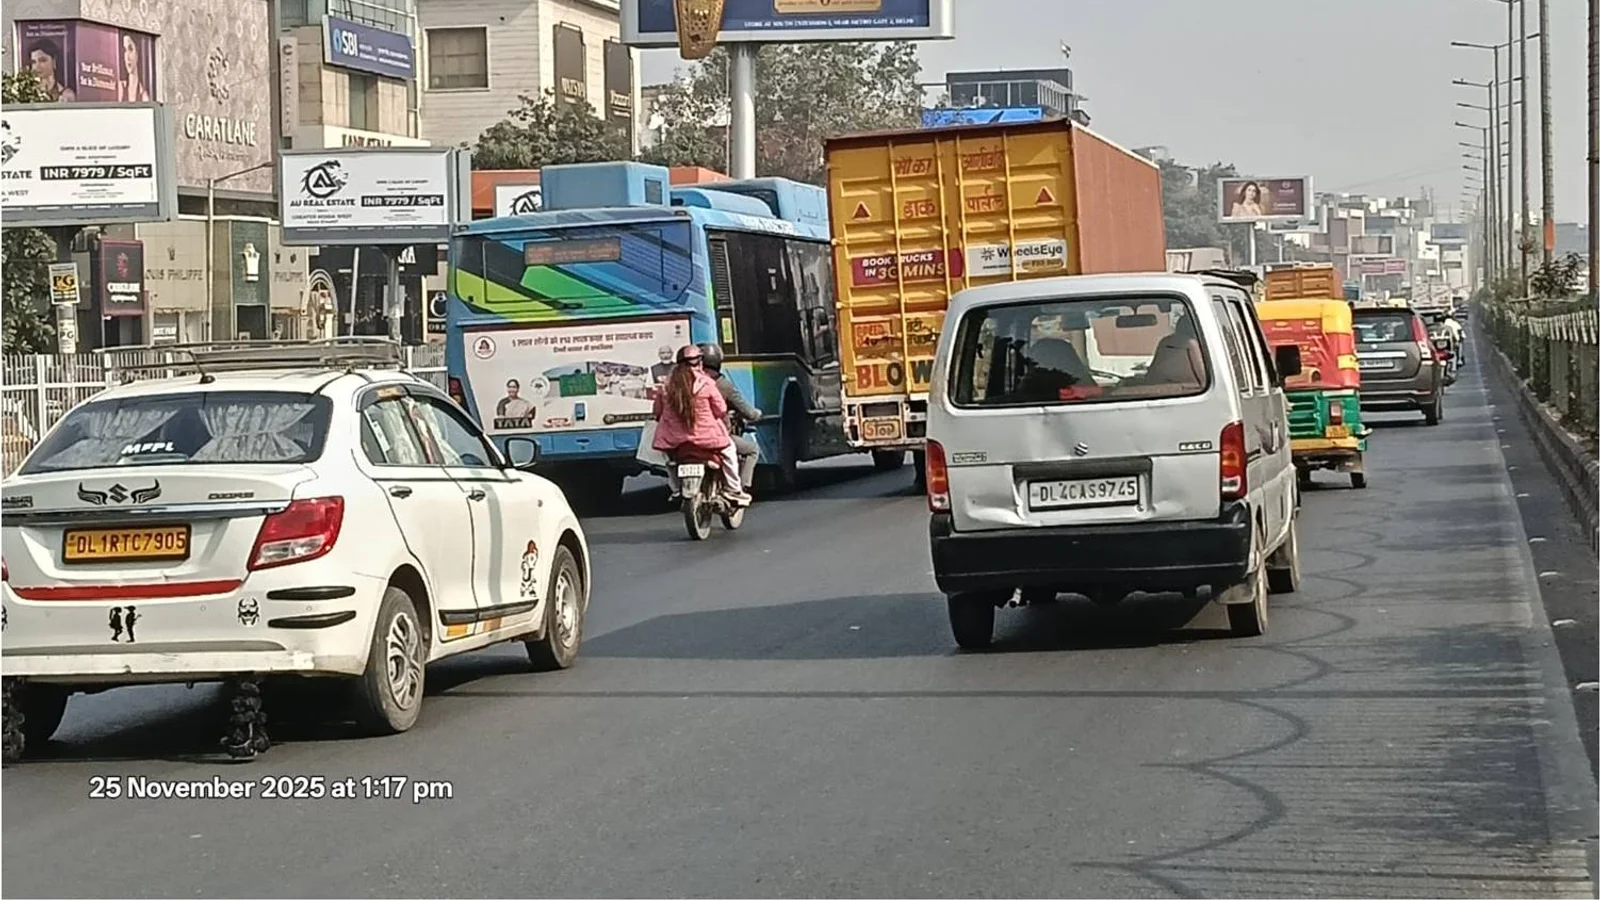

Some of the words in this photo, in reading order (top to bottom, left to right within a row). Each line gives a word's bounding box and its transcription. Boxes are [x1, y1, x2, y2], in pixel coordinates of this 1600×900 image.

[342, 30, 358, 56] SBI
[185, 113, 256, 147] CARATLANE
[1, 170, 32, 179] STATE
[44, 168, 69, 179] INR
[71, 167, 106, 178] 7979
[108, 166, 114, 178] /
[117, 166, 149, 180] SqFt
[326, 198, 356, 206] ESTATE
[363, 197, 382, 205] INR
[384, 196, 409, 205] 7979
[411, 196, 416, 205] /
[417, 196, 441, 207] SqFt
[862, 257, 891, 267] BOOK
[864, 268, 876, 276] IN
[904, 262, 944, 277] MINS
[53, 274, 75, 287] PG
[857, 360, 933, 388] BLOW
[495, 418, 531, 428] TATA
[1040, 481, 1136, 501] DL4CAS9745
[77, 531, 186, 554] DL1RTC7905
